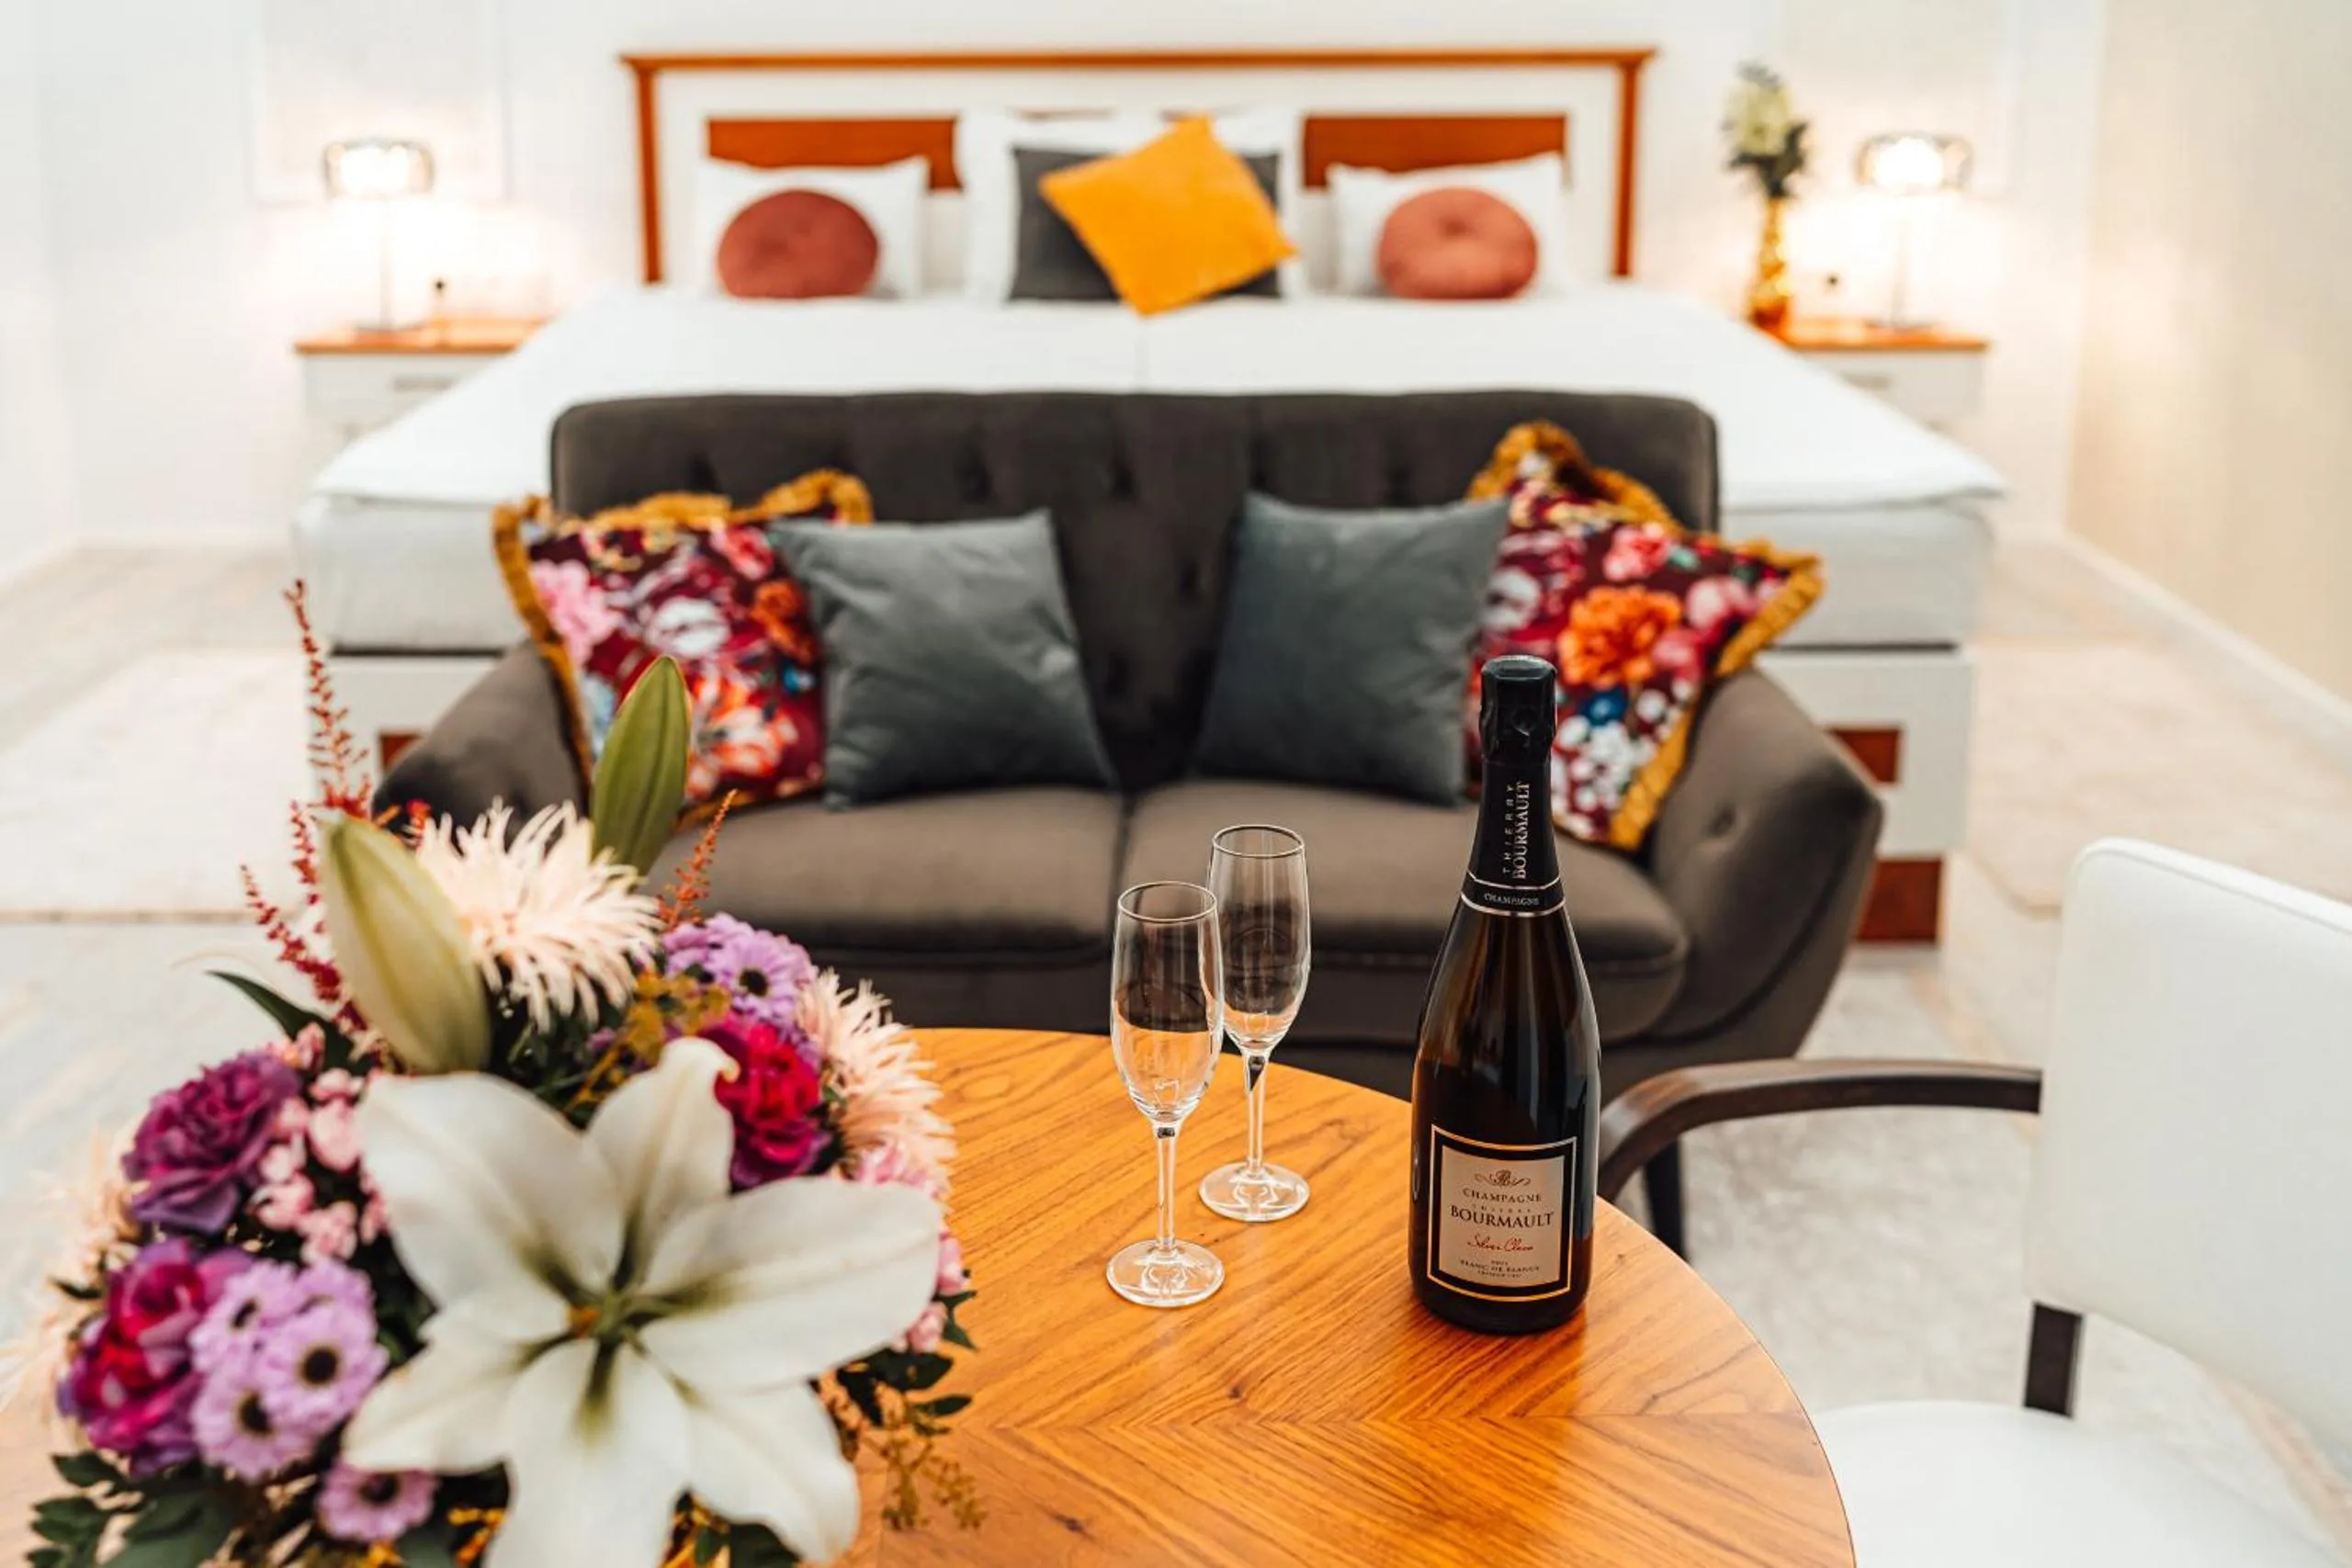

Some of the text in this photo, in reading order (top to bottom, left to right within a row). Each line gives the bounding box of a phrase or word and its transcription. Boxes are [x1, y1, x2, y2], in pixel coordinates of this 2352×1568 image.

[1502, 784, 1514, 874] THIERRY
[1511, 781, 1530, 879] BOURMAULT
[1451, 1204, 1555, 1228] BOURMAULT
[1462, 1187, 1542, 1203] CHAMPAGNE
